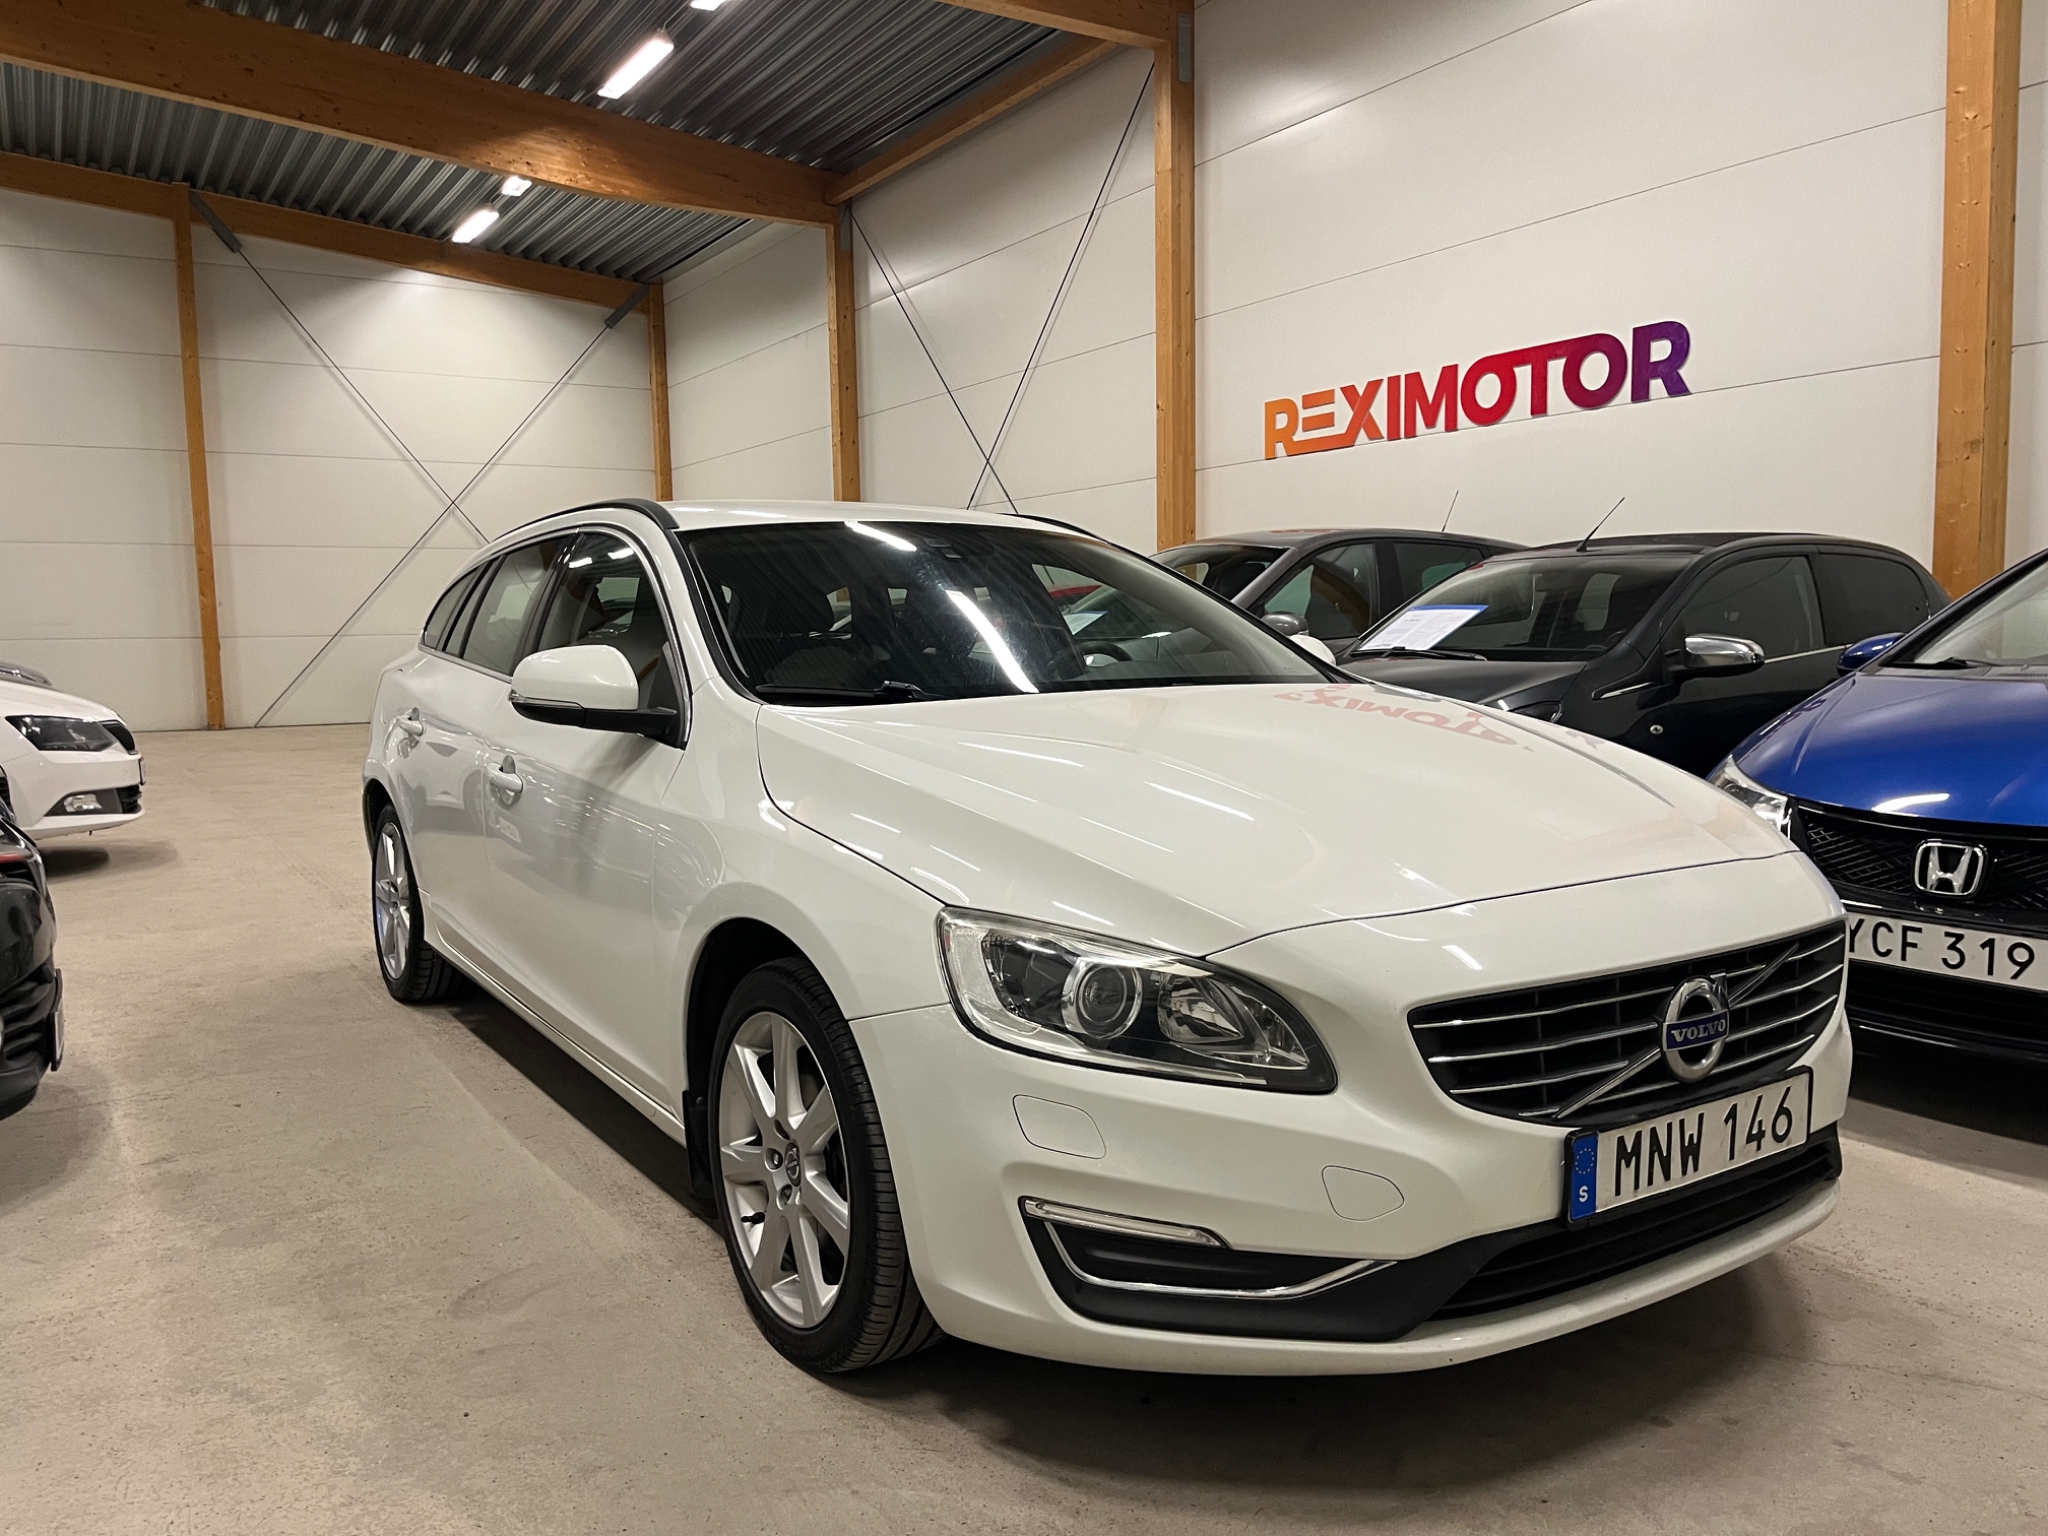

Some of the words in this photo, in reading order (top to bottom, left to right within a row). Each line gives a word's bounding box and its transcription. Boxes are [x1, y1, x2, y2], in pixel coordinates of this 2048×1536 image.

[1264, 320, 1692, 460] REXIMOTOR
[1849, 918, 1923, 962] YCF
[1941, 931, 2035, 980] 319
[1671, 1019, 1726, 1042] VOLVO
[1615, 1112, 1705, 1197] MNW
[1724, 1086, 1793, 1161] 146
[1579, 1185, 1588, 1202] S
